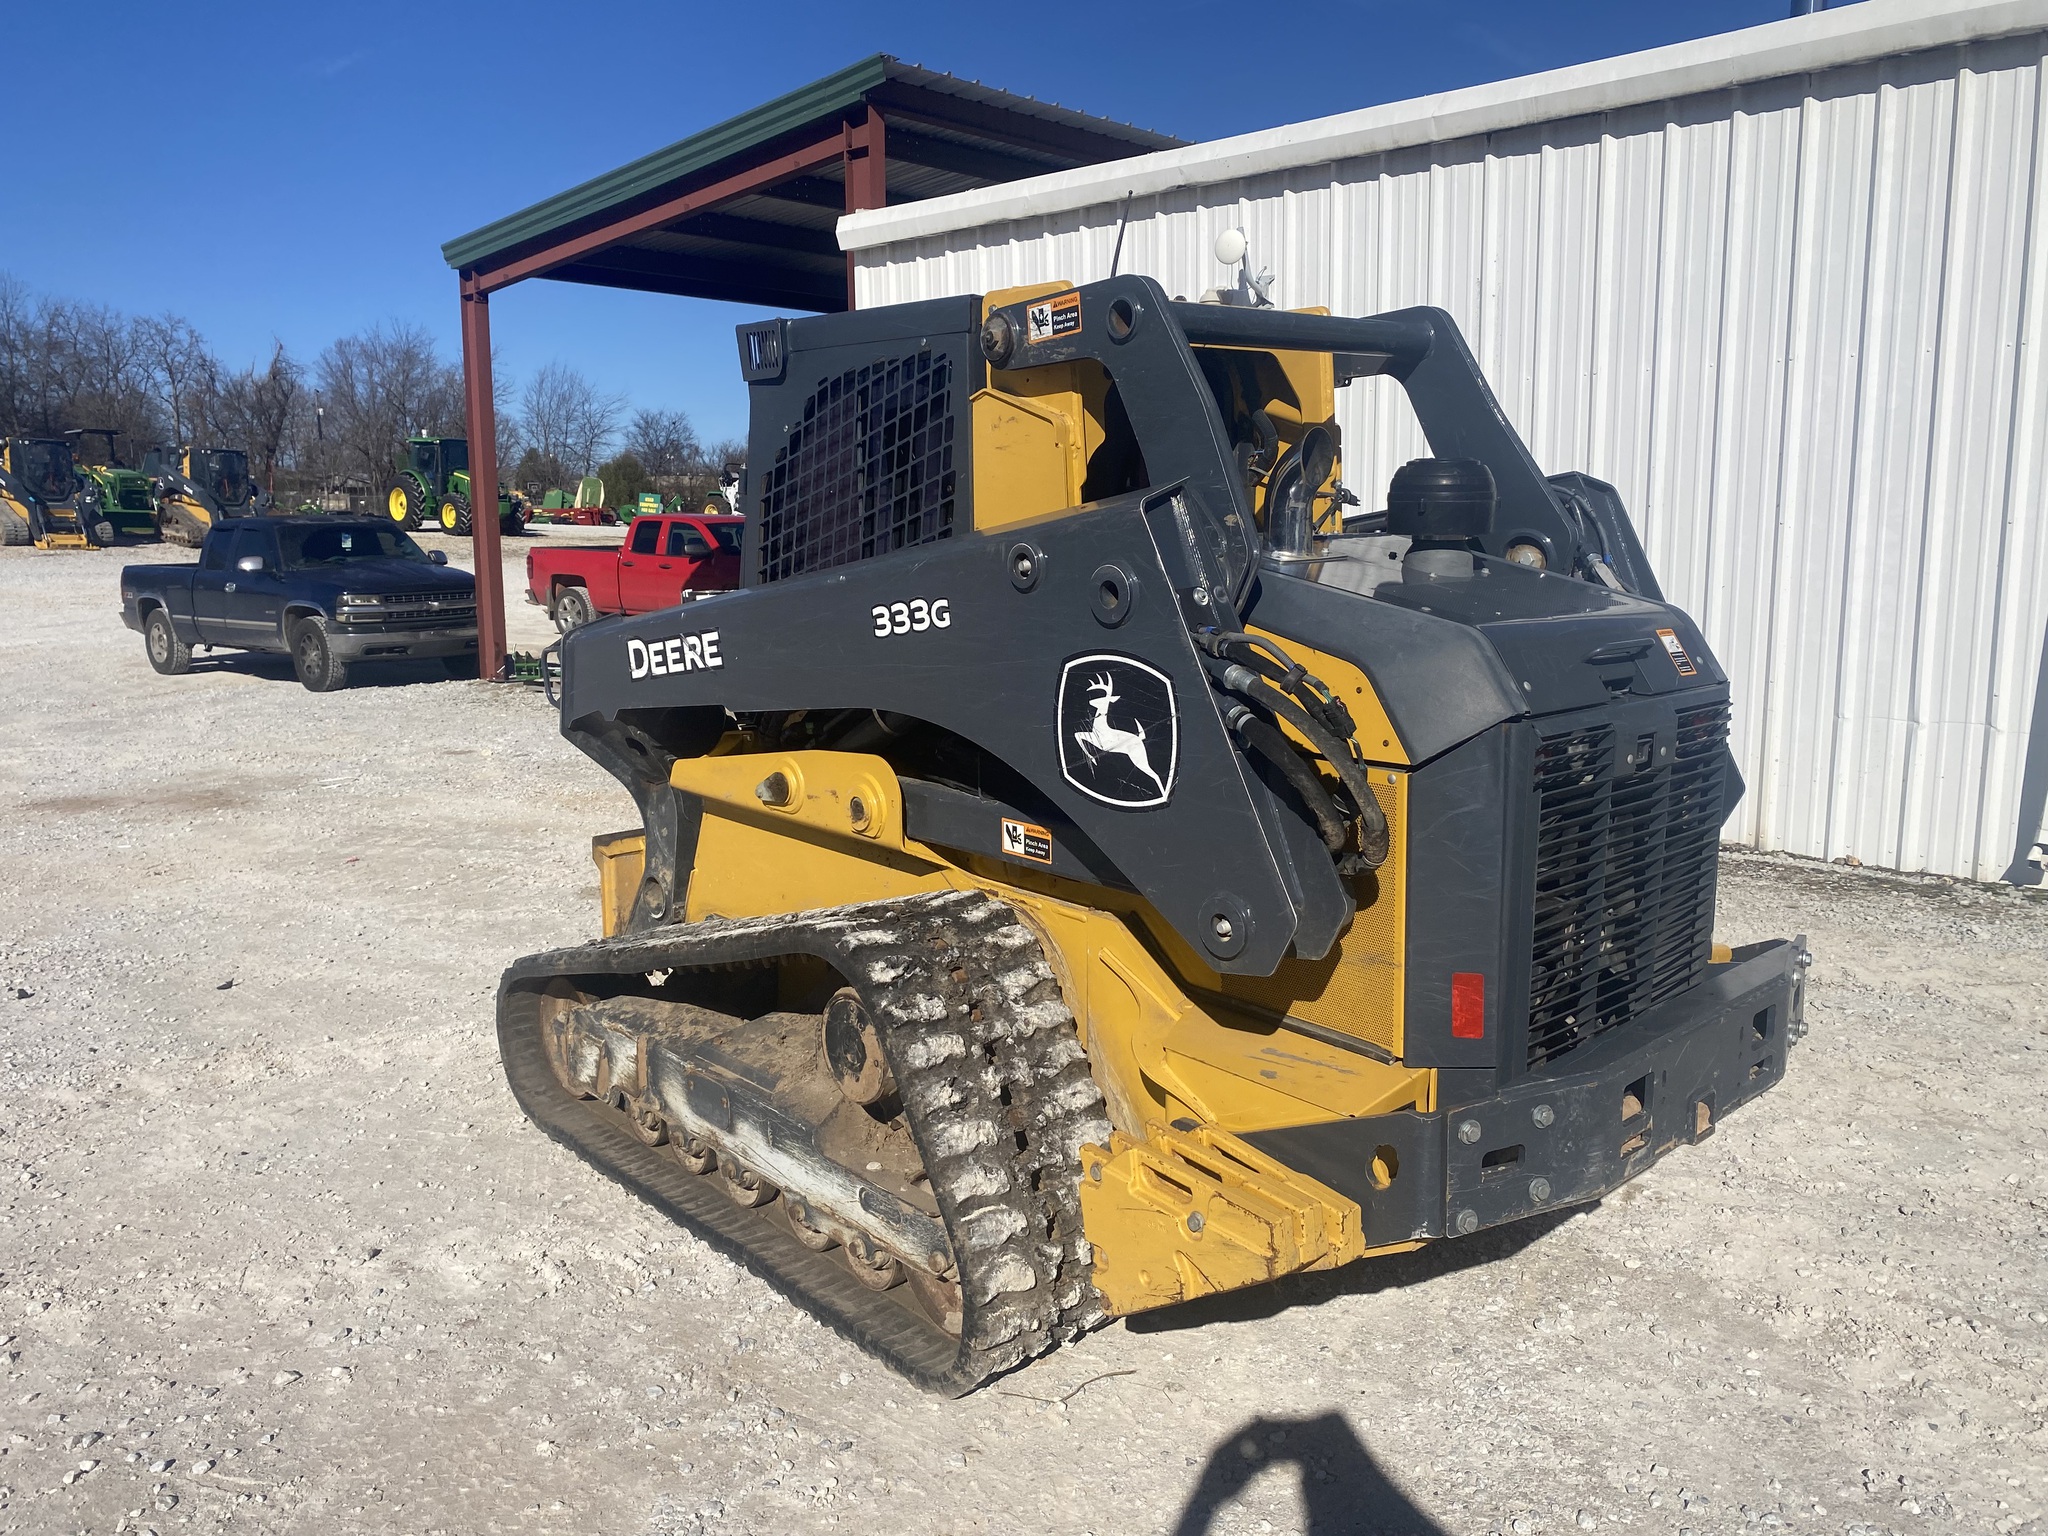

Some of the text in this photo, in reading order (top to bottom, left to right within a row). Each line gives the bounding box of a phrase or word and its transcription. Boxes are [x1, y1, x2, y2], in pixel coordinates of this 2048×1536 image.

[1057, 296, 1078, 306] WARNING
[1053, 311, 1077, 322] Pinch Area
[872, 598, 951, 637] 333G
[627, 631, 722, 680] DEERE
[1025, 838, 1038, 846] Pinch
